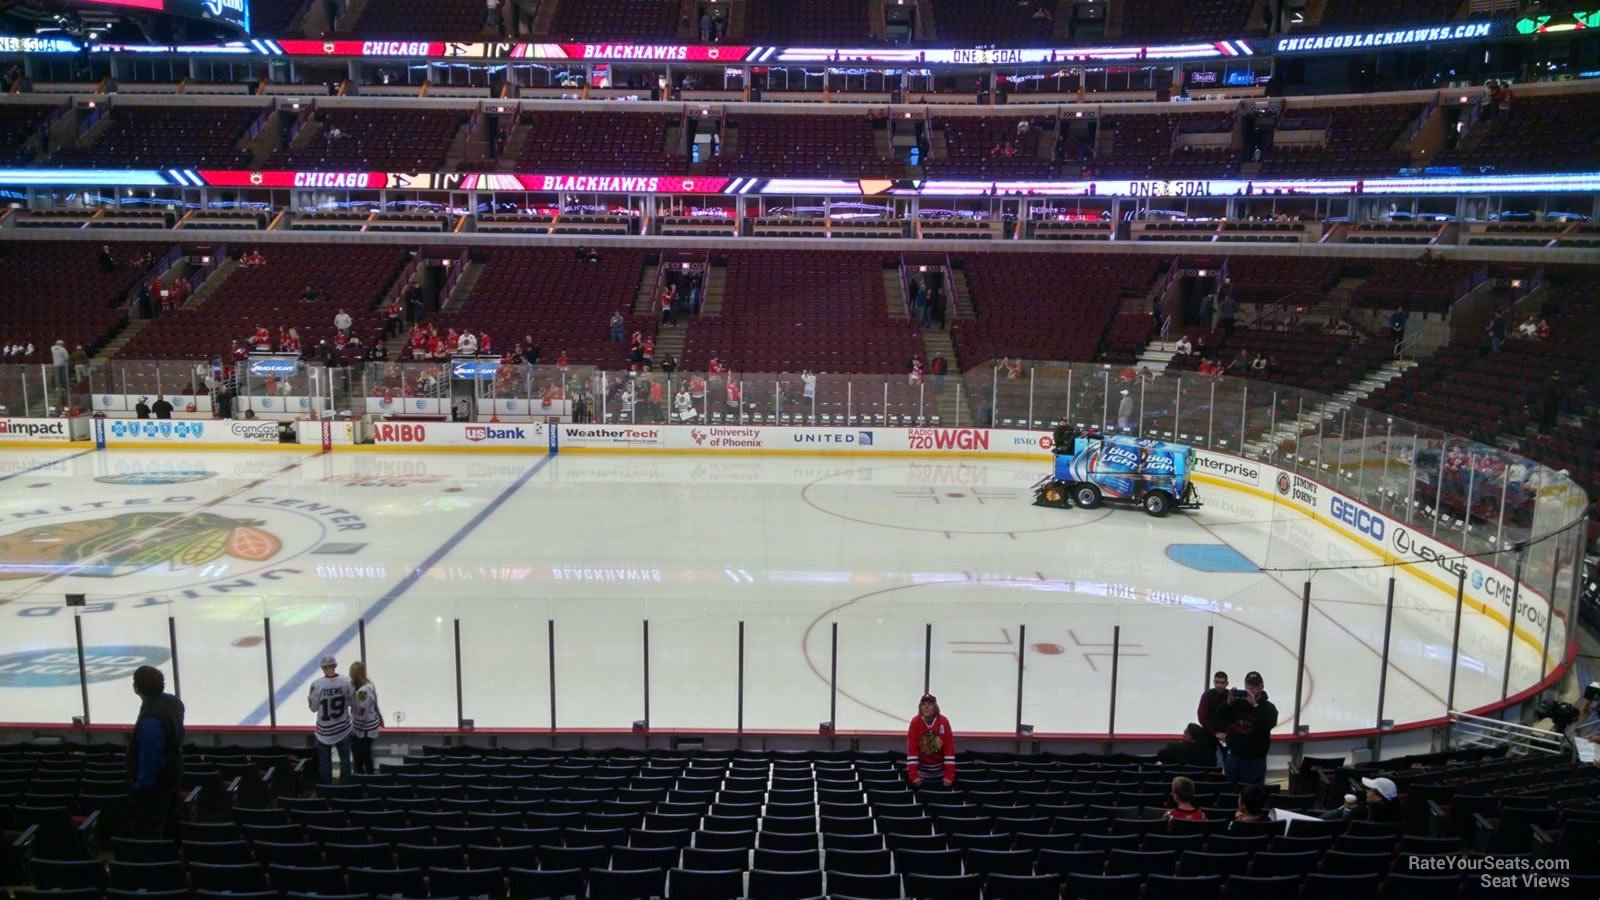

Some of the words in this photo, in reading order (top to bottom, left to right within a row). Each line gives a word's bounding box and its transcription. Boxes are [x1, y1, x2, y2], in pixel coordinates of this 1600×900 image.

[1278, 23, 1490, 51] CHICAGOBLACKHAWKS.COM
[0, 39, 16, 51] NE
[362, 42, 428, 55] CHICAGO
[584, 45, 687, 59] BLACKHAWKS
[953, 50, 977, 62] ONE
[992, 50, 1022, 62] GOAL
[294, 172, 368, 187] CHICAGO
[543, 176, 659, 191] BLACKHAWKS
[1130, 182, 1158, 196] ONE
[1176, 181, 1211, 196] GOAL
[8, 419, 64, 436] impact
[566, 429, 657, 438] WeatherTech
[710, 428, 760, 440] University
[710, 438, 721, 447] of
[723, 438, 761, 447] Phoenix
[794, 433, 855, 443] UNITED
[908, 436, 933, 449] 720
[934, 429, 989, 450] WGN
[1014, 437, 1037, 446] BMO
[1108, 447, 1138, 461] BUD
[1146, 454, 1173, 465] BUD
[1101, 454, 1138, 470] LIGHT
[1293, 475, 1318, 494] JIMMY
[1292, 488, 1317, 507] JOHN'S
[246, 496, 367, 532] CENTER
[1331, 496, 1384, 541] GEICO
[1411, 540, 1468, 580] LEXUS
[1485, 576, 1512, 607] CME
[320, 696, 345, 721] 19
